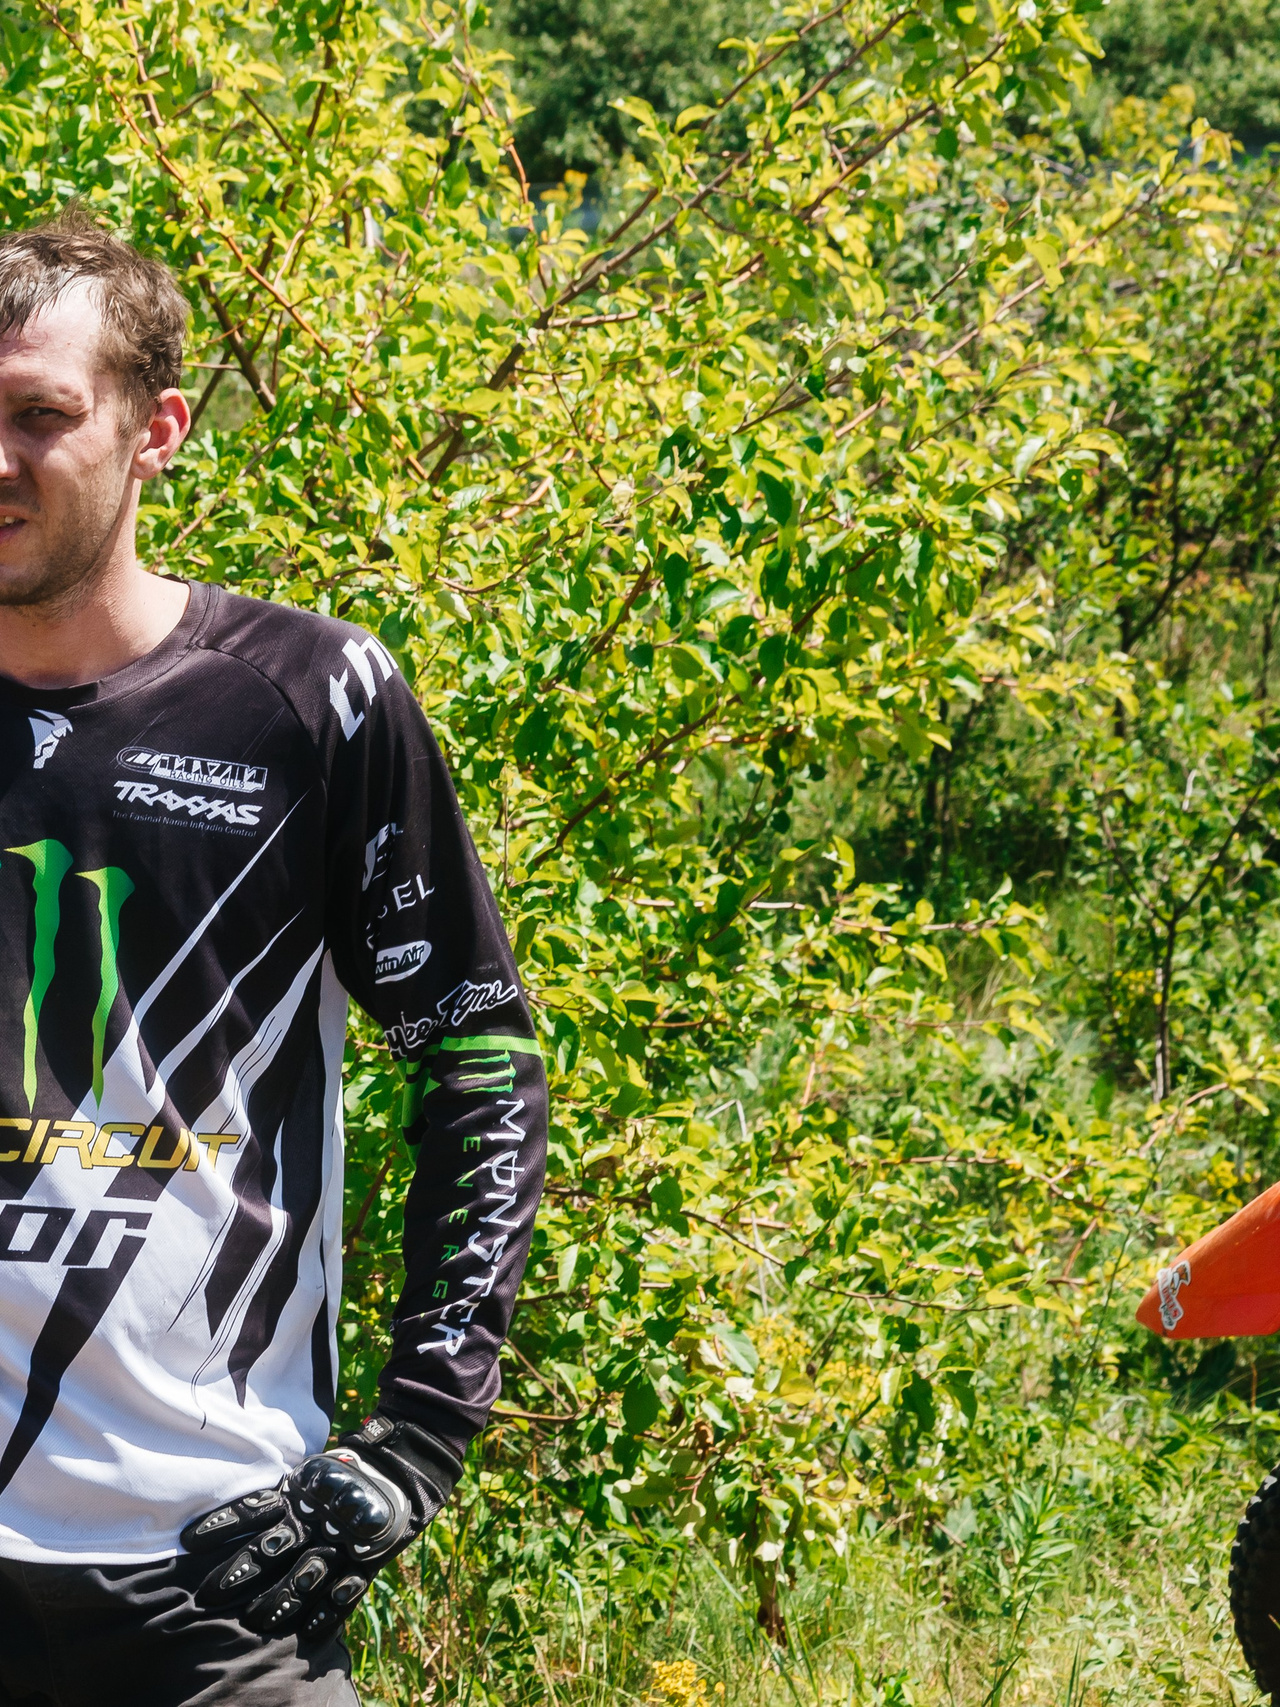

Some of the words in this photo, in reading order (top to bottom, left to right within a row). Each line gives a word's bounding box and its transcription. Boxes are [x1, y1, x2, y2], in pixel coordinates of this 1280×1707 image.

[170, 770, 213, 784] RACING
[113, 780, 264, 826] TRAXXAS
[224, 825, 258, 838] Control
[399, 945, 426, 967] Air
[429, 1135, 481, 1302] ENERG
